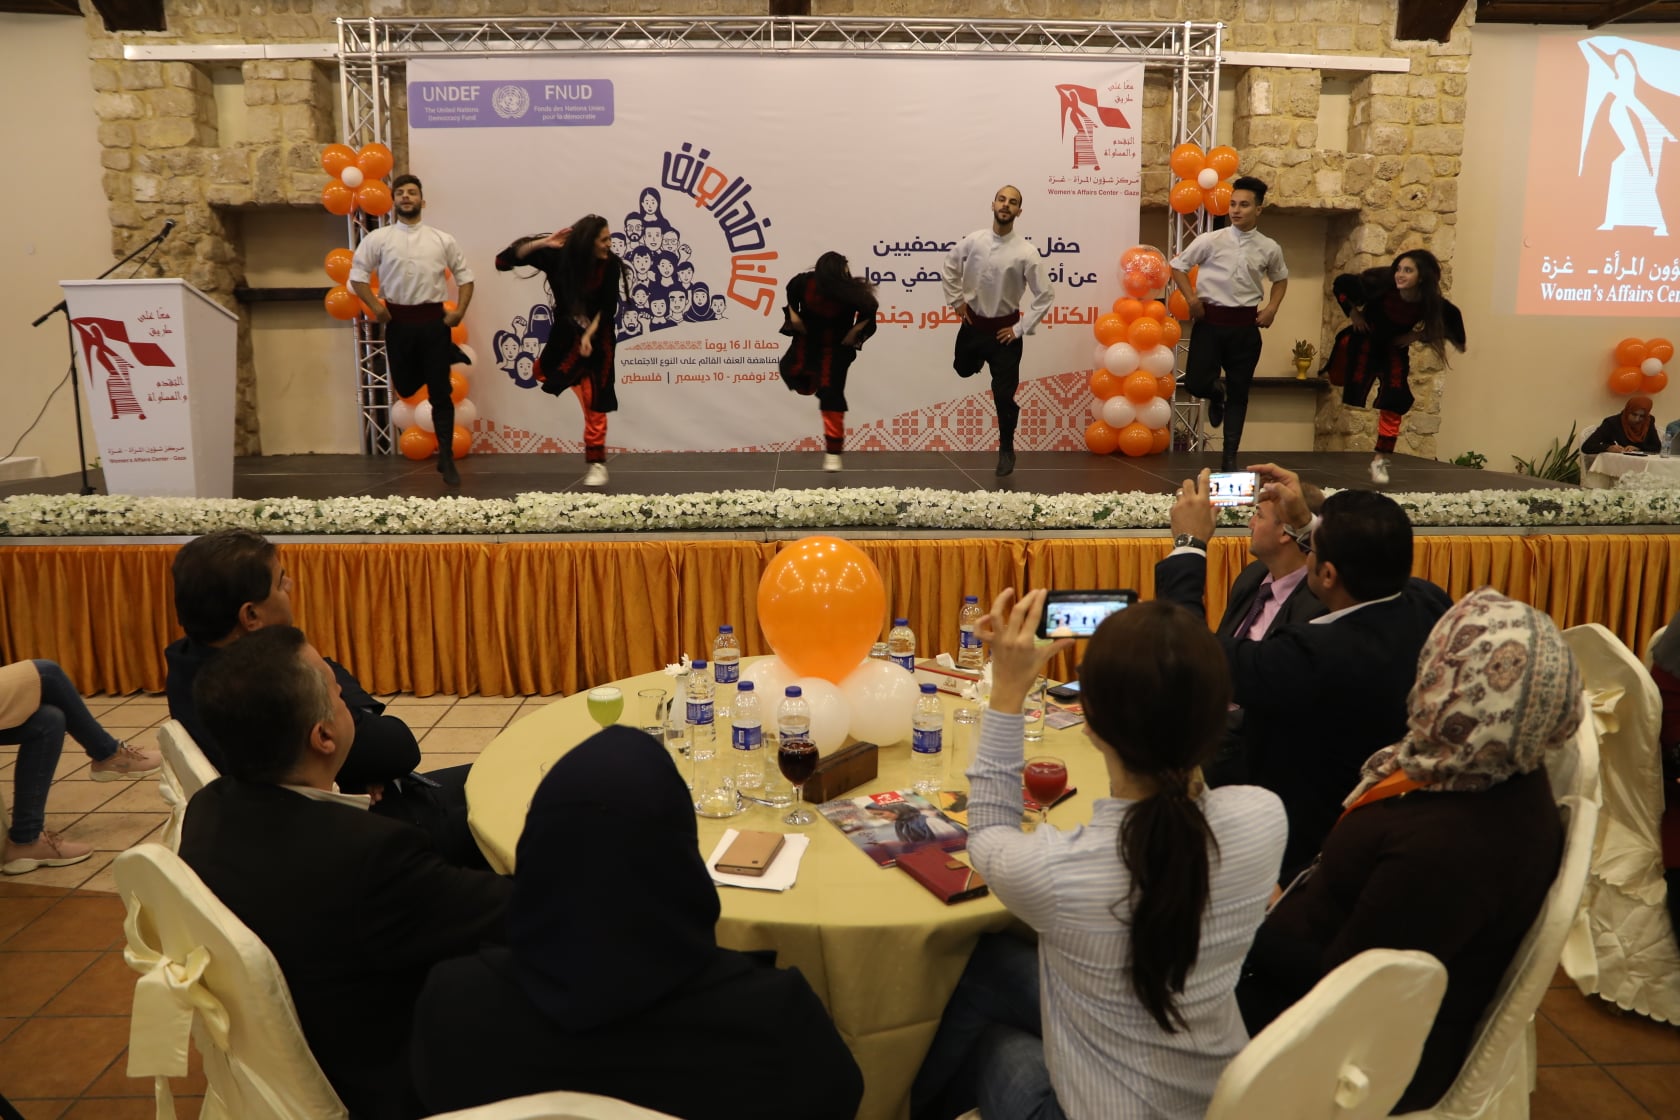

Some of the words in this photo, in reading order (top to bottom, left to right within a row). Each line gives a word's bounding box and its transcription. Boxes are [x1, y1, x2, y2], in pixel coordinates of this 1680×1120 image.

[422, 86, 480, 102] UNDEF
[545, 85, 592, 100] FNUD
[1048, 175, 1066, 184] غزة
[1115, 177, 1140, 185] مركز
[1047, 188, 1076, 196] Women's
[1037, 237, 1080, 258] حفل
[1542, 255, 1574, 279] غزة
[1604, 249, 1645, 280] المرأة
[1649, 258, 1680, 282] ؤون
[901, 267, 943, 292] حفي
[1068, 271, 1097, 288] عن
[1540, 283, 1603, 302] Women's
[1606, 284, 1654, 303] Affairs
[1656, 285, 1680, 303] Cen
[730, 340, 740, 349] 16
[754, 340, 779, 350] حملة
[620, 357, 657, 367] الاجتماعي
[660, 357, 677, 367] النوع
[680, 357, 696, 365] على
[698, 357, 721, 367] القائم
[723, 356, 745, 365] العنف
[747, 356, 779, 365] لمناهضة
[621, 372, 662, 385] فلسطين
[674, 371, 711, 384] ديسمبر
[713, 371, 724, 381] 10
[732, 371, 766, 384] نوفمبر
[769, 371, 780, 381] 25
